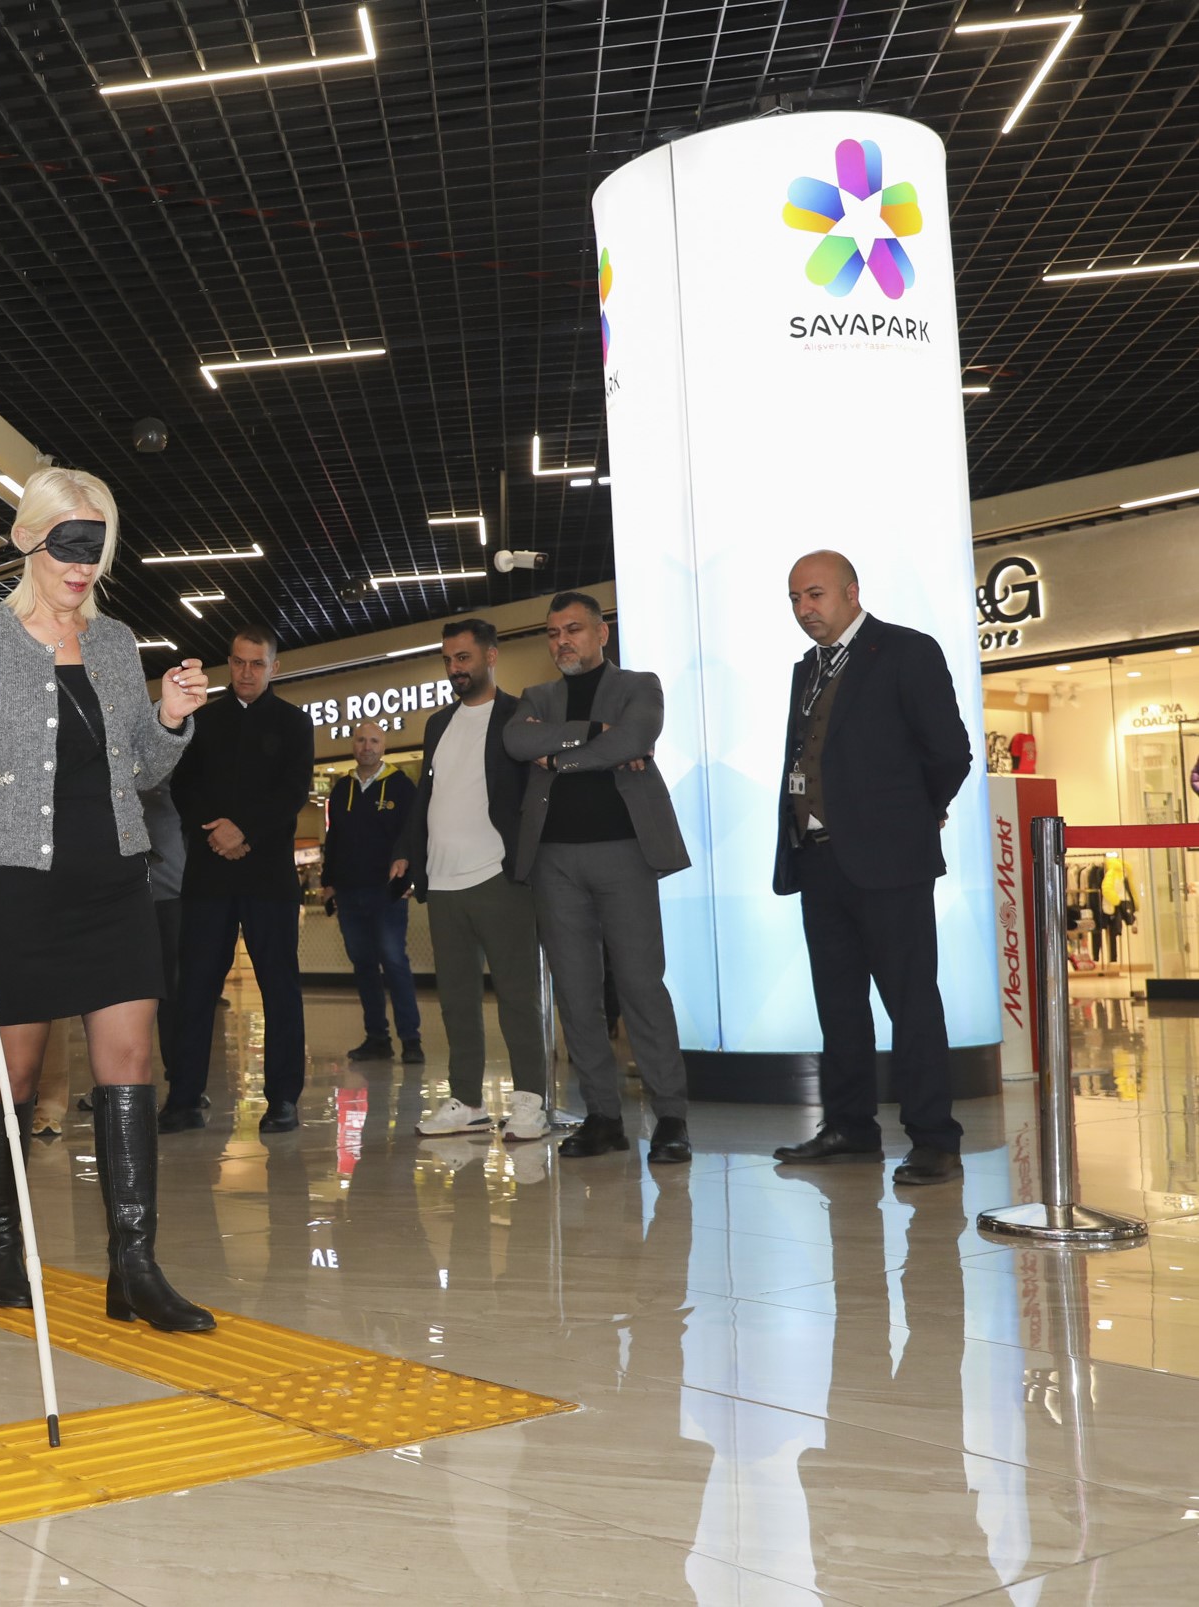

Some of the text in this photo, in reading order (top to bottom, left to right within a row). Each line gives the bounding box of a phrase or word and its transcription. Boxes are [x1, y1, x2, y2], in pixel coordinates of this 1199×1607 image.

[789, 313, 931, 343] SAYAPARK
[976, 556, 1041, 626] &G
[979, 629, 1020, 650] ore
[302, 679, 454, 726] ES ROCHER
[1141, 703, 1183, 716] POVA
[330, 716, 403, 740] FRCE
